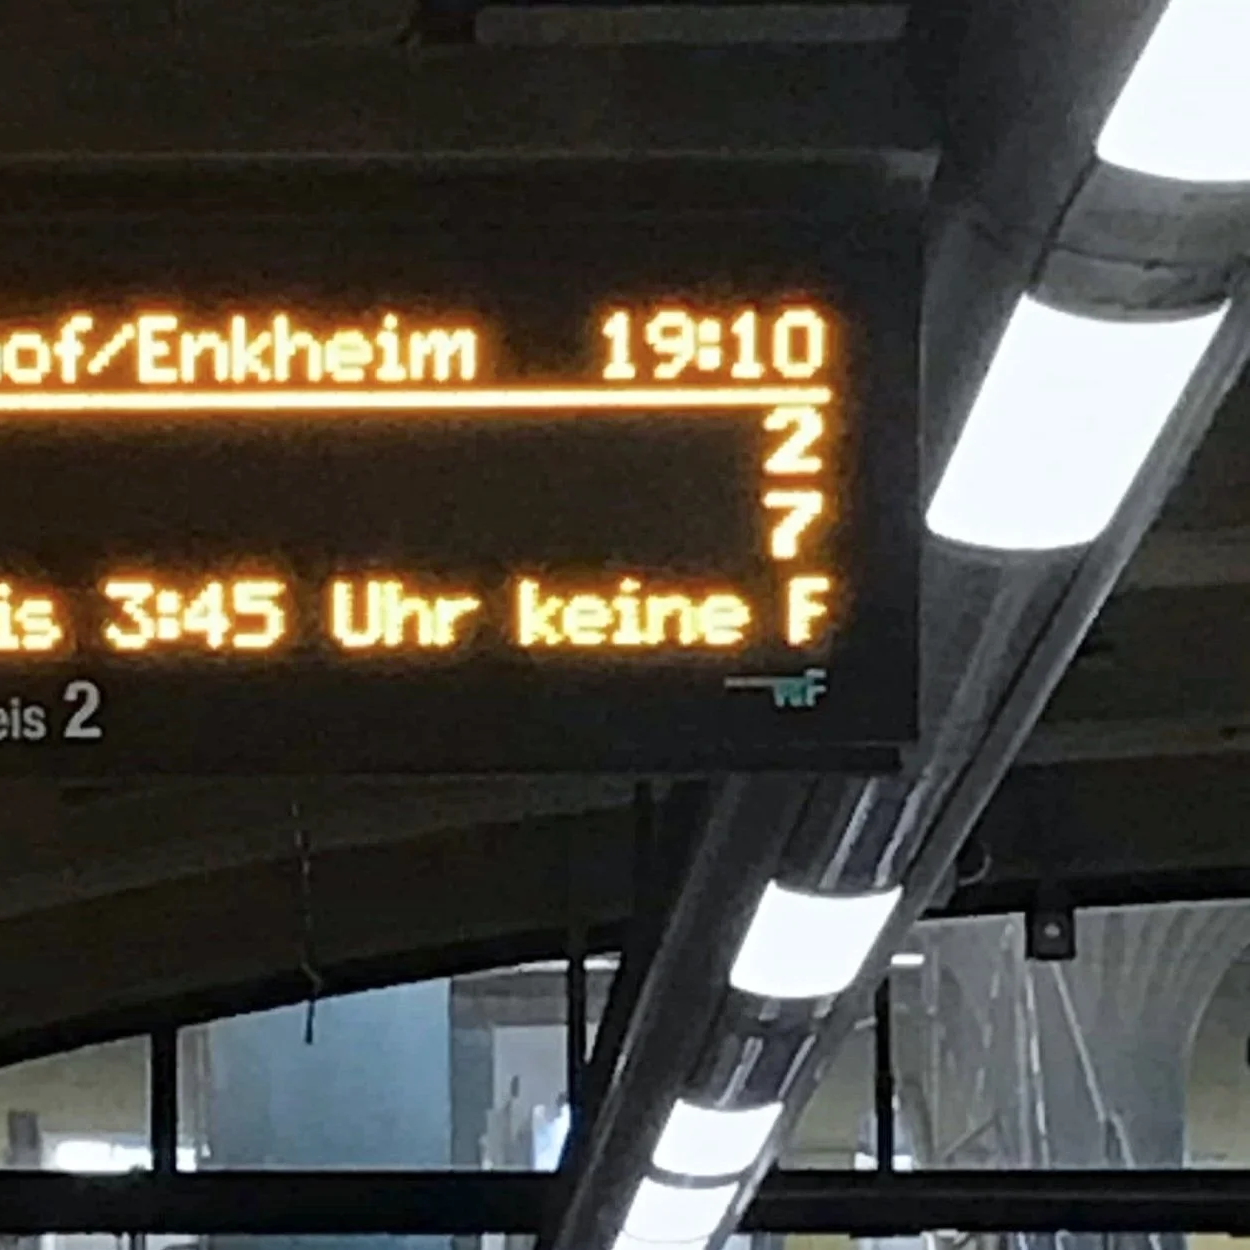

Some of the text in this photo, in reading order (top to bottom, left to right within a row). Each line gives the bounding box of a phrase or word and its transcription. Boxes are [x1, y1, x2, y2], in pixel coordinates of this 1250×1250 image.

[603, 309, 825, 379] 19:10
[764, 406, 823, 473] 2
[764, 491, 823, 558] 7
[105, 580, 284, 649] 3:45
[333, 581, 479, 647] Uhr
[518, 578, 750, 645] keine
[788, 577, 829, 644] F
[64, 679, 103, 738] 2
